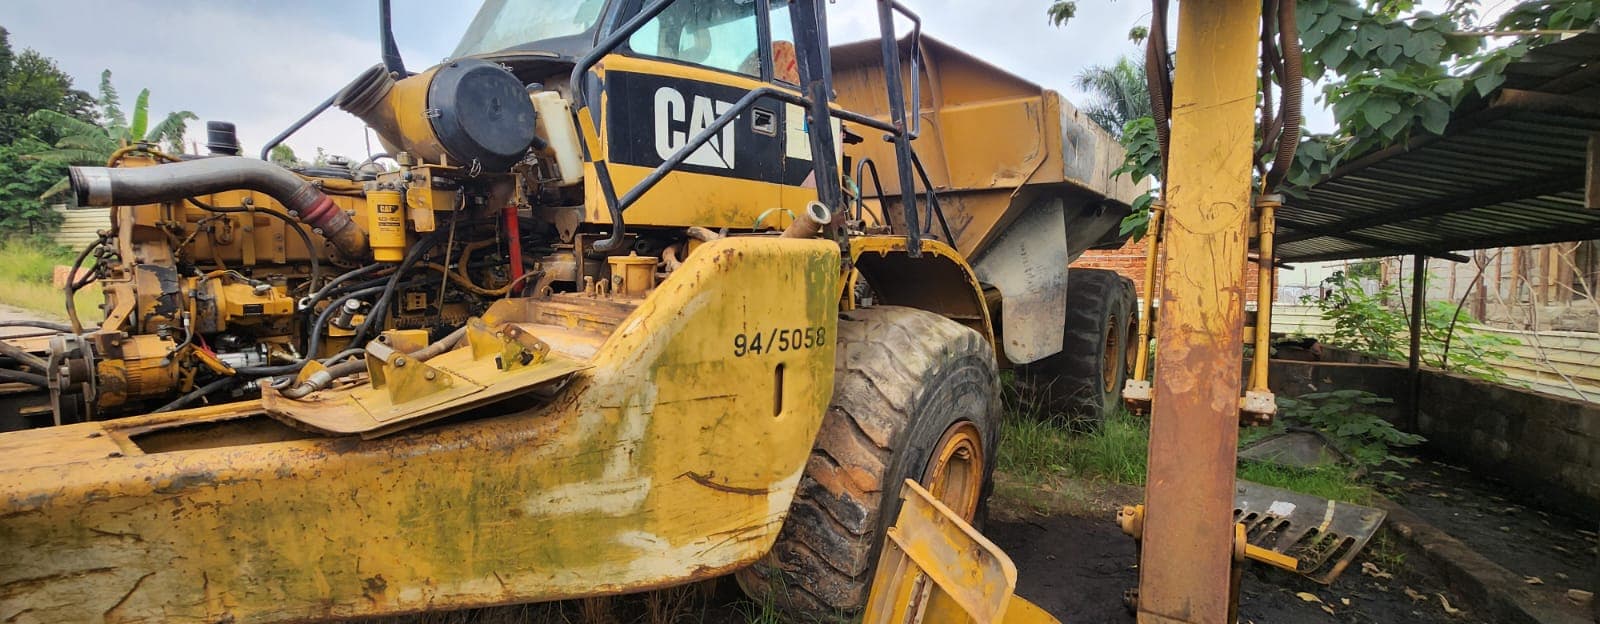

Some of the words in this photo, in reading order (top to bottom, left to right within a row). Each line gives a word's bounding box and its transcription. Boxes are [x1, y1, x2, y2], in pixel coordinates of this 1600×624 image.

[654, 86, 740, 170] CAT
[379, 205, 393, 213] CAT
[734, 326, 826, 357] 94/5058
